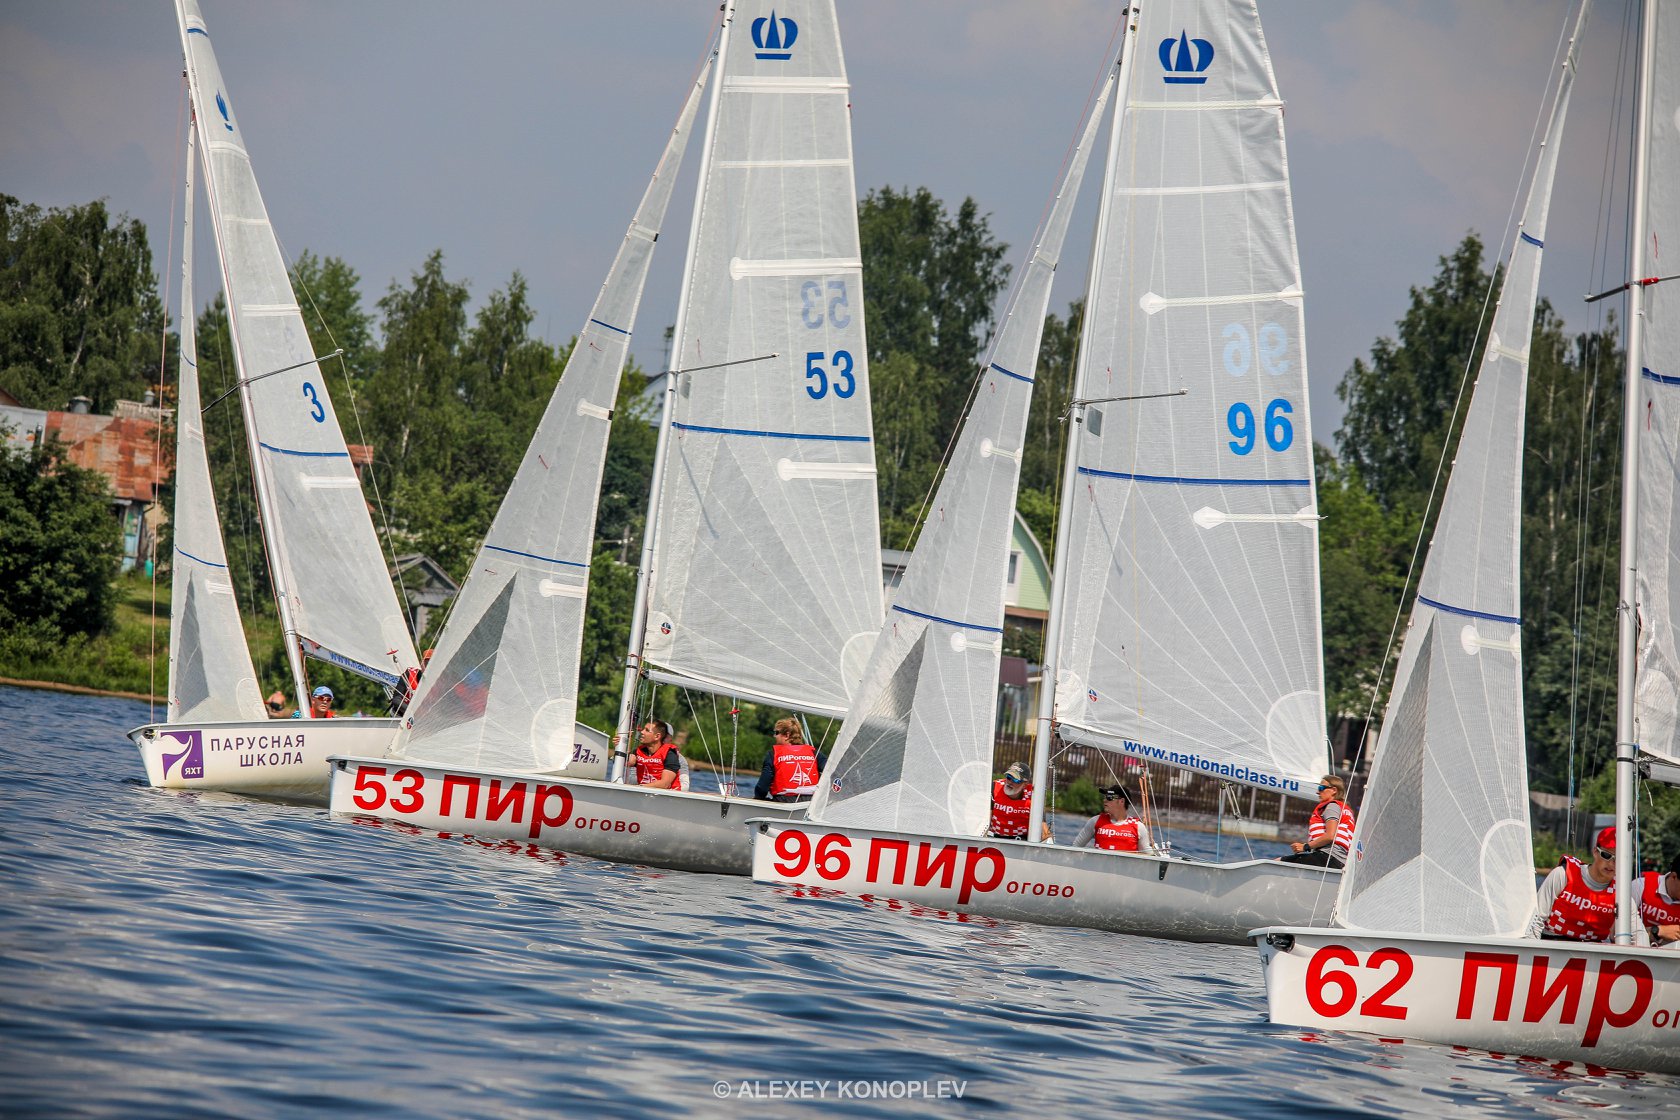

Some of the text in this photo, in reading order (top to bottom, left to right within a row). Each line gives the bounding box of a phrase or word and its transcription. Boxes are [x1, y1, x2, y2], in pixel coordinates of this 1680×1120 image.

[805, 349, 856, 400] 53
[303, 381, 326, 423] 3
[1226, 398, 1294, 456] 96
[210, 734, 305, 751] ПАРУСНАЯ
[240, 751, 303, 767] ШКОЛА
[1123, 739, 1300, 792] www.nationalclass.ru
[184, 766, 202, 776] ЯХТ
[352, 765, 425, 814] 53
[773, 829, 852, 881] 96
[1305, 944, 1414, 1020] 62
